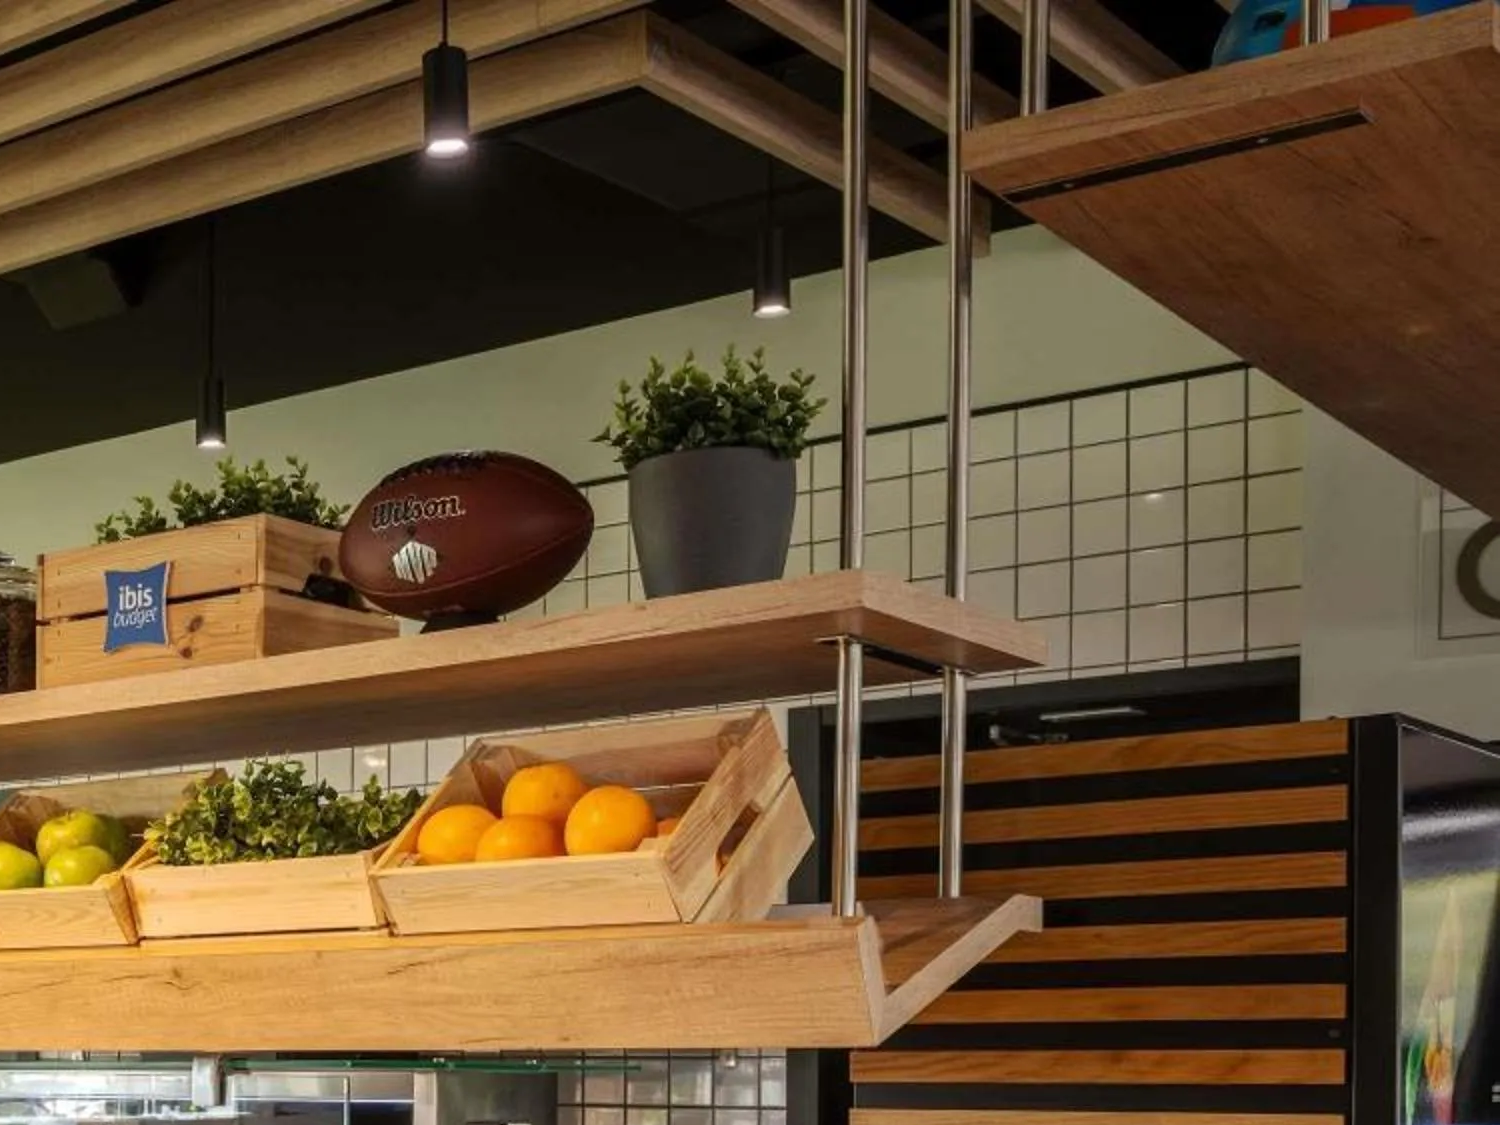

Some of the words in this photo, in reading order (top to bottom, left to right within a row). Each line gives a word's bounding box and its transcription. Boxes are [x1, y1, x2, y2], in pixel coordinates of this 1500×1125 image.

[371, 494, 461, 531] Wilson
[118, 583, 154, 611] ibis
[112, 606, 158, 629] budget
